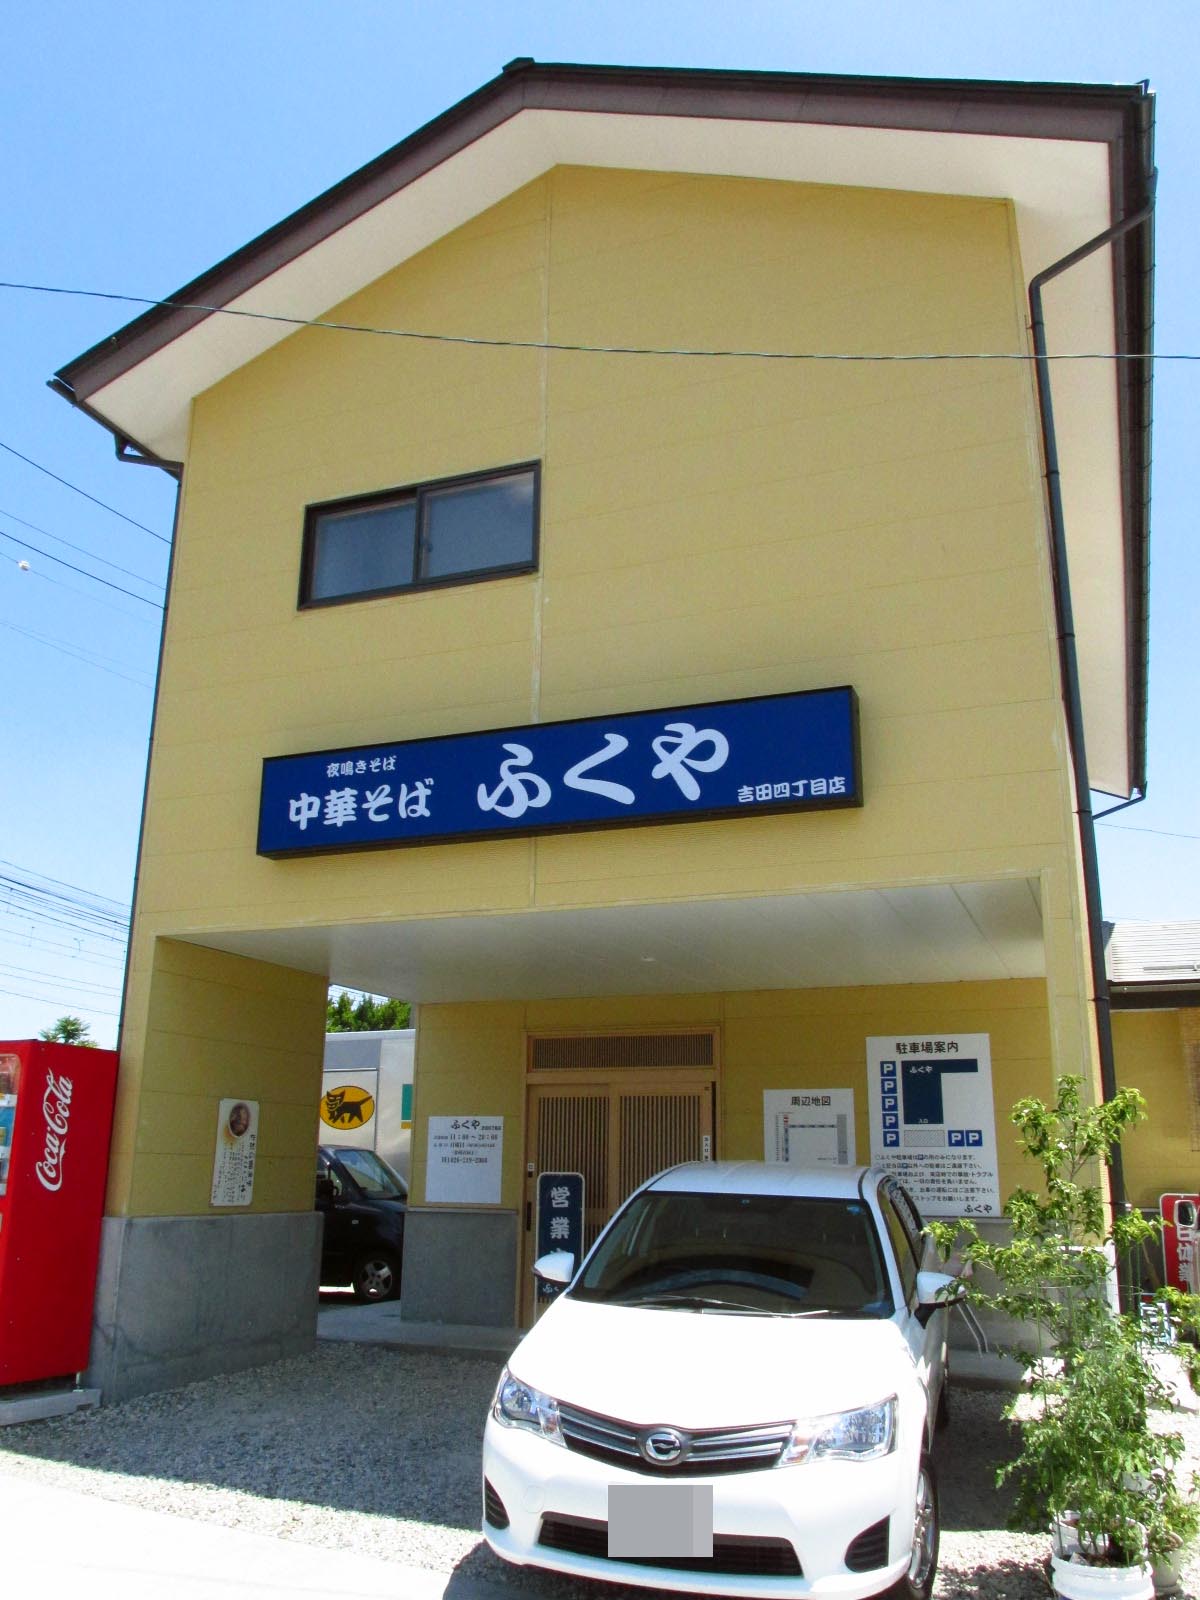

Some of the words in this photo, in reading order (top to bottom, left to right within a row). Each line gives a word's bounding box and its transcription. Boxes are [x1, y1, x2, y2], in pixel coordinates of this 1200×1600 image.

[326, 755, 397, 778] 夜鳴きそば
[477, 722, 729, 819] ふくや
[737, 776, 846, 803] 吉田四丁目店
[289, 778, 434, 831] 中華そば
[895, 1041, 959, 1055] 駐車場案内
[791, 1096, 831, 1106] 周辺地図
[35, 1067, 73, 1192] Coca-Cola
[451, 1120, 481, 1130] ふくや
[550, 1186, 571, 1254] 営業
[964, 1204, 993, 1213] ふくや
[542, 1283, 560, 1294] ふく
